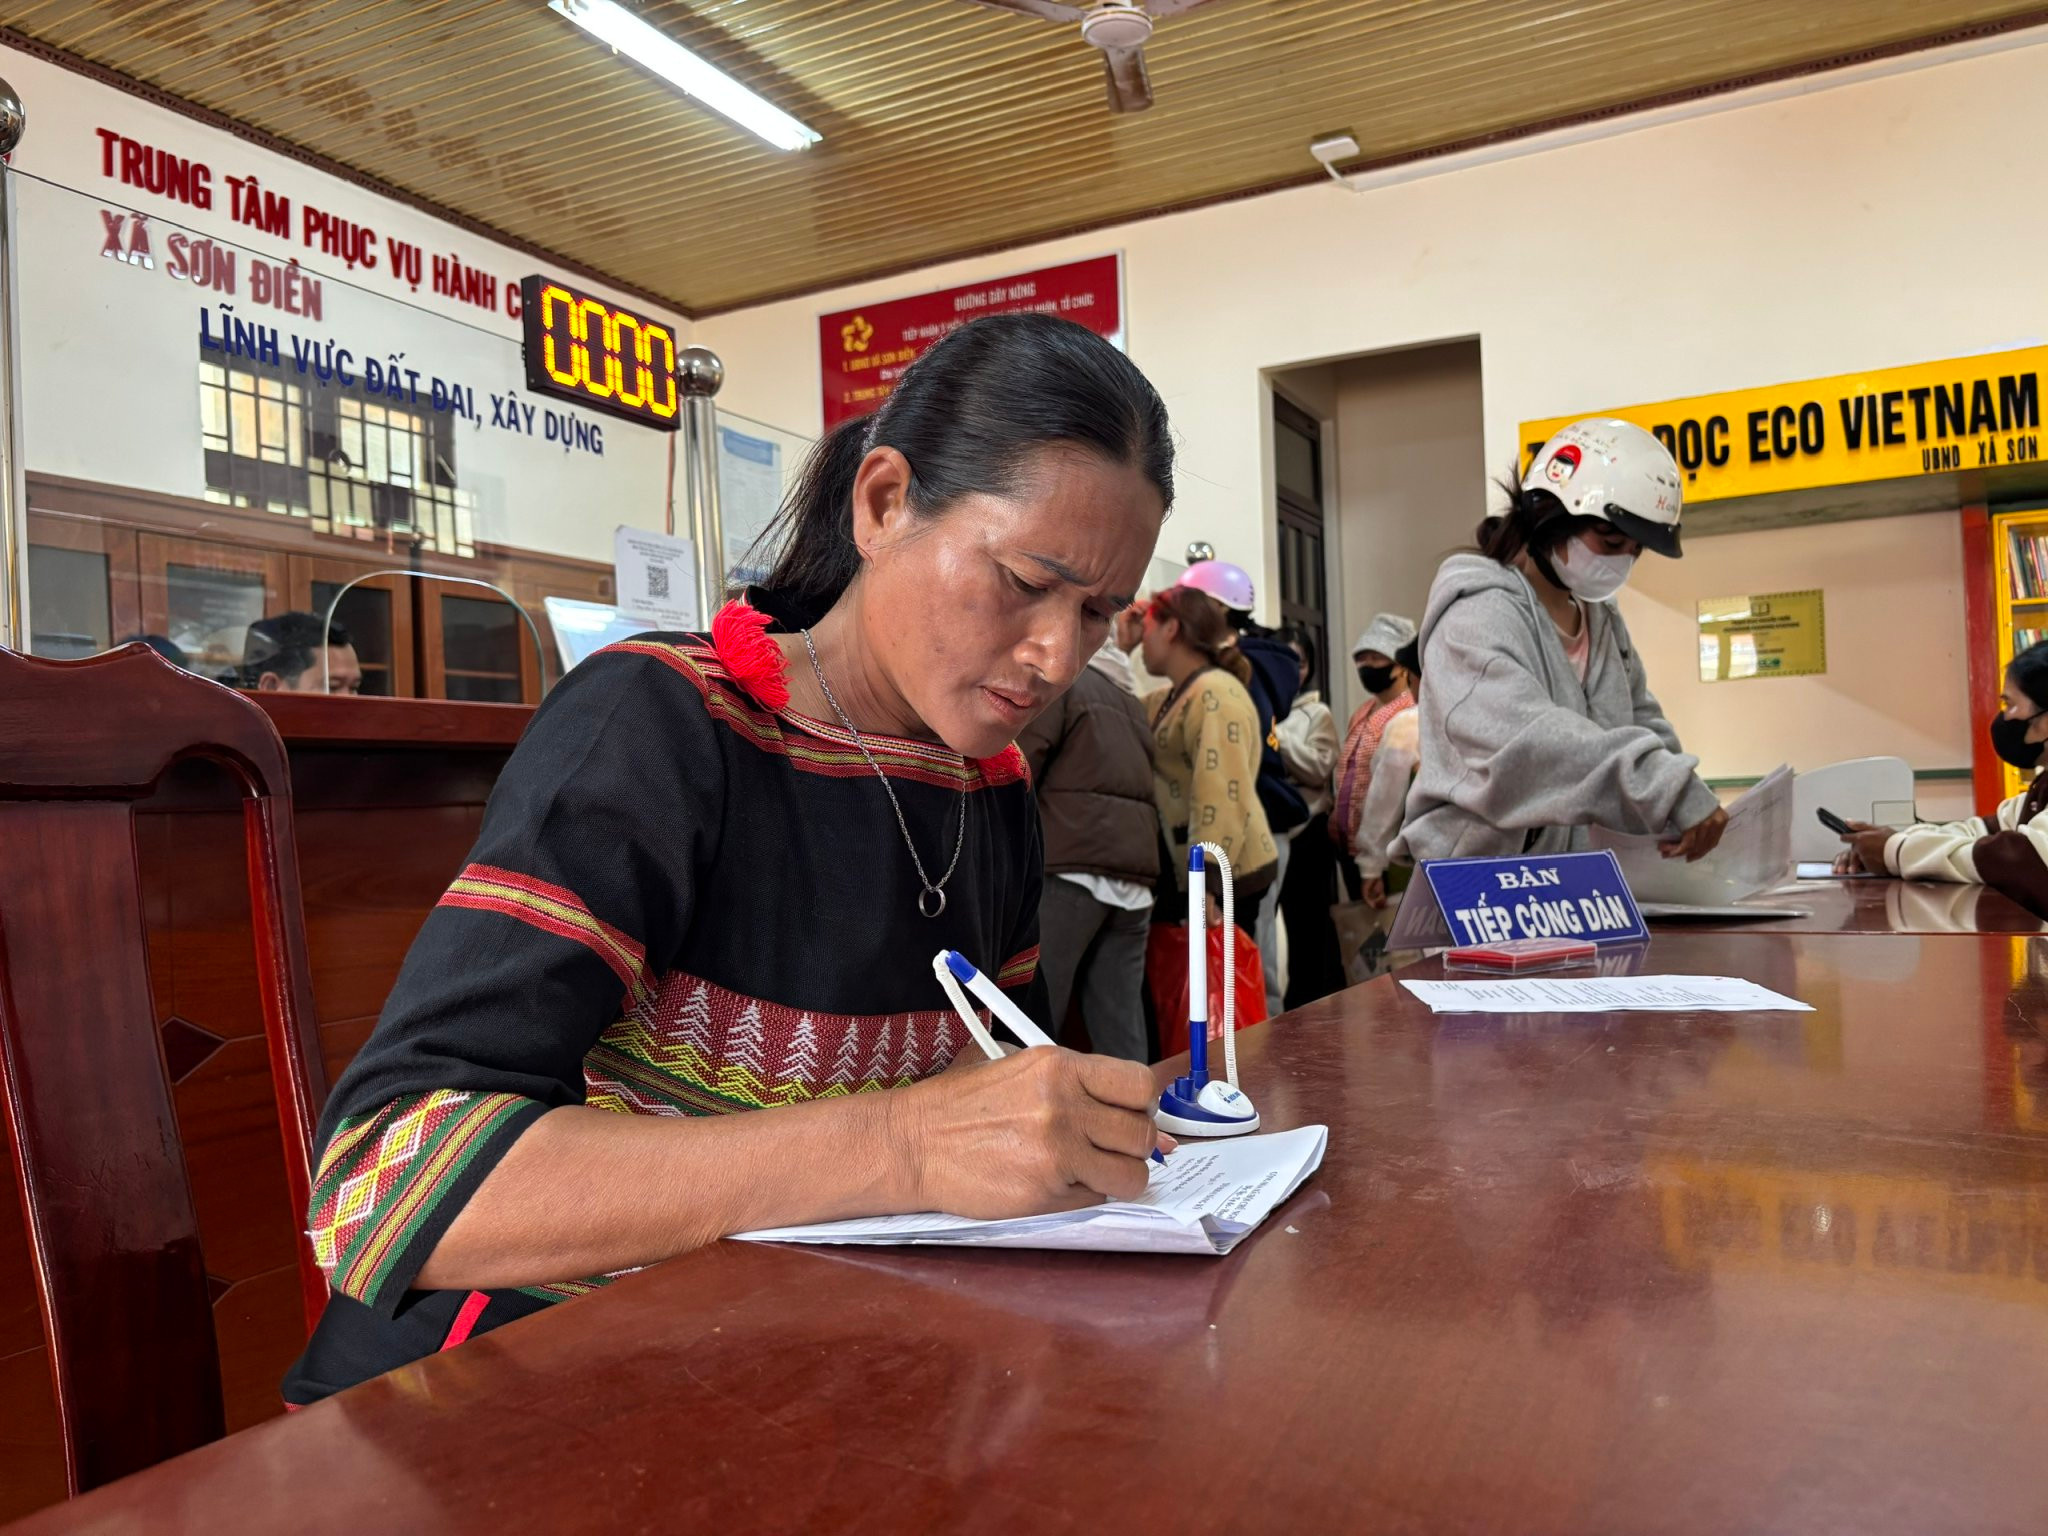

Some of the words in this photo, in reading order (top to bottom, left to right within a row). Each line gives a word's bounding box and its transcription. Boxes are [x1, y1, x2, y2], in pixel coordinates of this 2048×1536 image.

[96, 127, 212, 211] TRUNG
[225, 175, 291, 240] TÂM
[303, 204, 377, 271] PHỤC
[387, 236, 422, 293] VỤ
[432, 252, 497, 313] HÀNH
[100, 209, 155, 271] XÃ
[166, 232, 236, 296] SƠN
[249, 257, 322, 322] ĐIỀN
[200, 303, 279, 367] LĨNH
[291, 335, 355, 388] VỰC
[365, 352, 421, 404] ĐẤT
[431, 376, 482, 431] ĐAI,
[490, 390, 536, 436] XÂY
[544, 411, 604, 457] DỰNG
[1747, 401, 1825, 463] ECO
[1839, 372, 2040, 450] VIETNAM
[1922, 445, 1961, 471] UBND
[2007, 434, 2038, 462] SƠN
[1455, 891, 1513, 945] TIẾP
[1514, 894, 1585, 939] CÔNG
[1578, 888, 1632, 932] DÂN
[1495, 865, 1561, 889] BÀN
